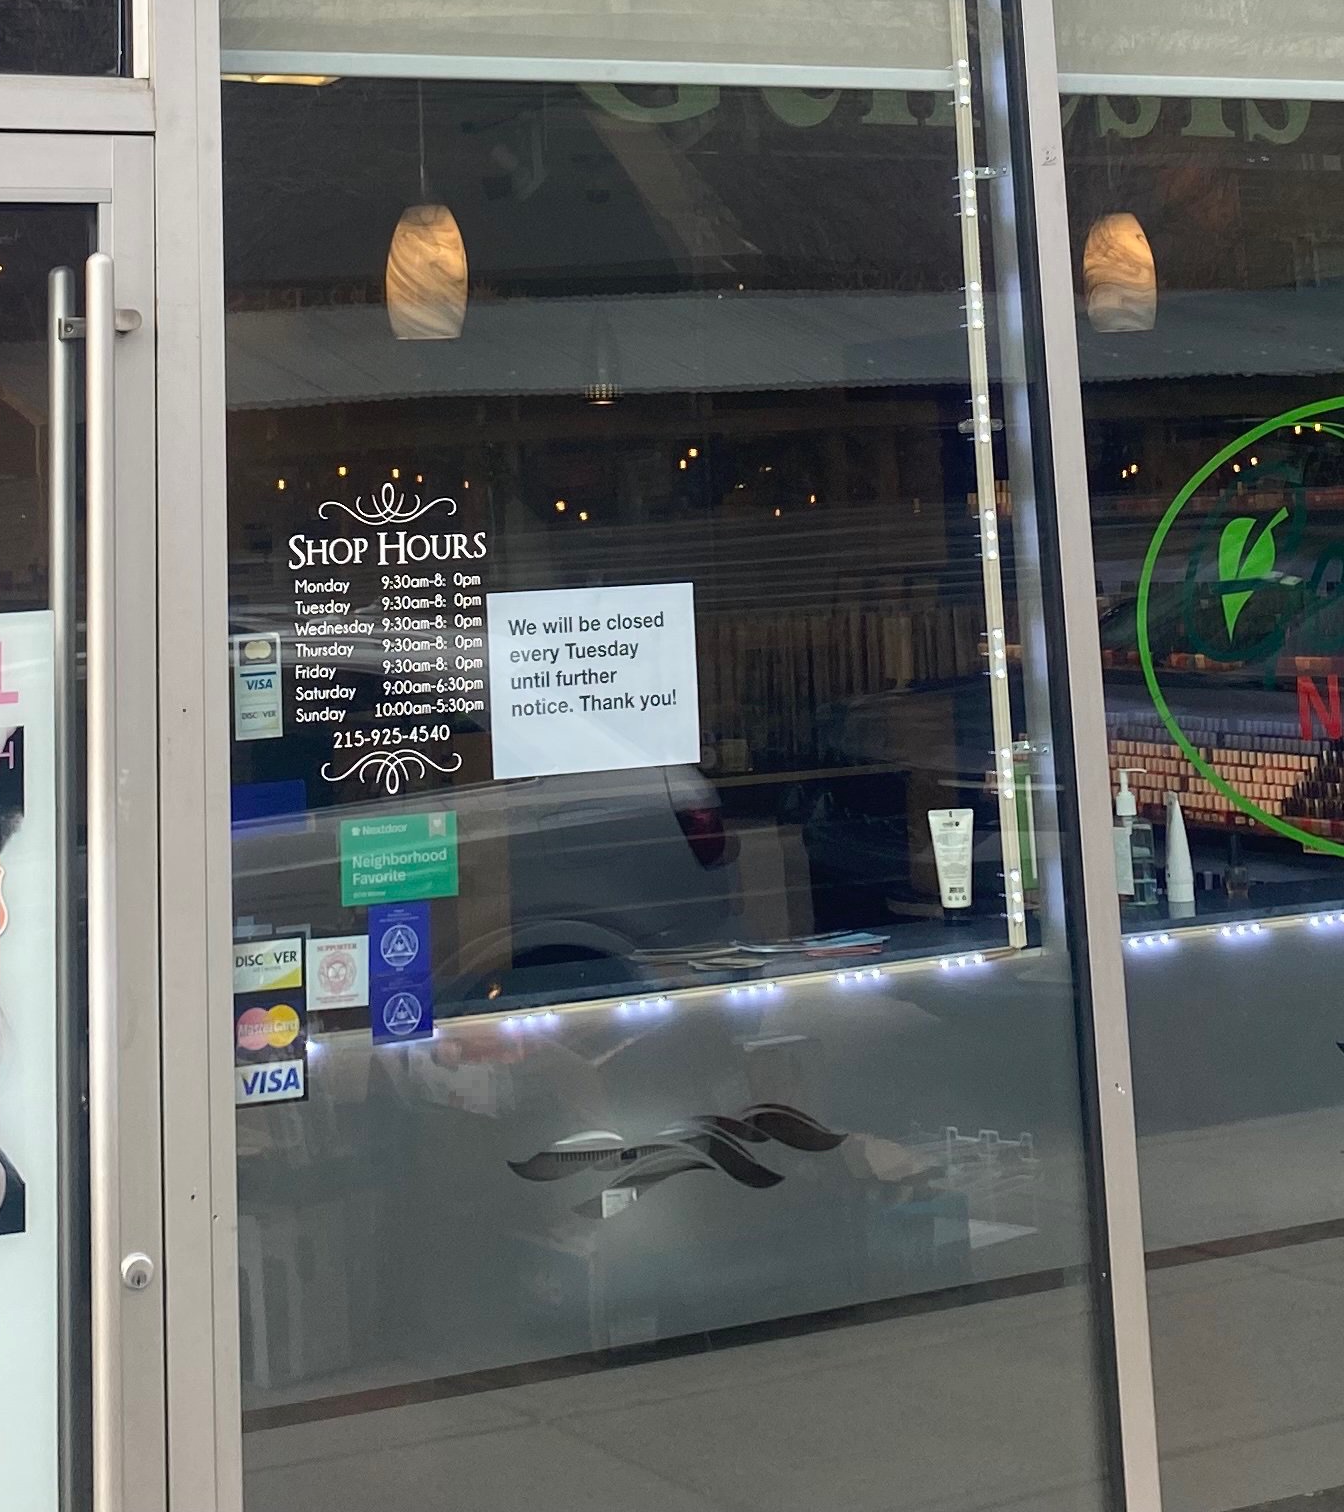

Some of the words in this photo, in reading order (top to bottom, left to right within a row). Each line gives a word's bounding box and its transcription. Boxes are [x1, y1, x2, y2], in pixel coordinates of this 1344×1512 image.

[294, 578, 350, 594] Monday
[294, 599, 351, 616] Tuesday
[294, 620, 374, 637] Wednesday
[508, 619, 537, 636] We
[543, 616, 573, 634] will
[579, 615, 601, 633] be
[606, 611, 665, 630] closed
[295, 642, 354, 659] Thursday
[510, 647, 559, 664] every
[565, 640, 639, 660] Tuesday
[295, 665, 336, 681] Friday
[511, 670, 550, 690] until
[556, 668, 617, 687] further
[245, 678, 273, 691] VISA
[295, 685, 356, 702] Saturday
[383, 676, 484, 696] 9:00am-6:30pm
[295, 708, 346, 724] Sunday
[375, 697, 484, 718] 10:00am-5:30pm
[511, 699, 574, 717] notice.
[579, 692, 634, 712] Thank
[640, 689, 677, 712] you!
[241, 710, 276, 720] DISCVER
[333, 724, 450, 749] 215-925-4540
[352, 848, 447, 869] Neighborhood
[352, 869, 407, 886] Favorite
[241, 1067, 301, 1097] VISA
